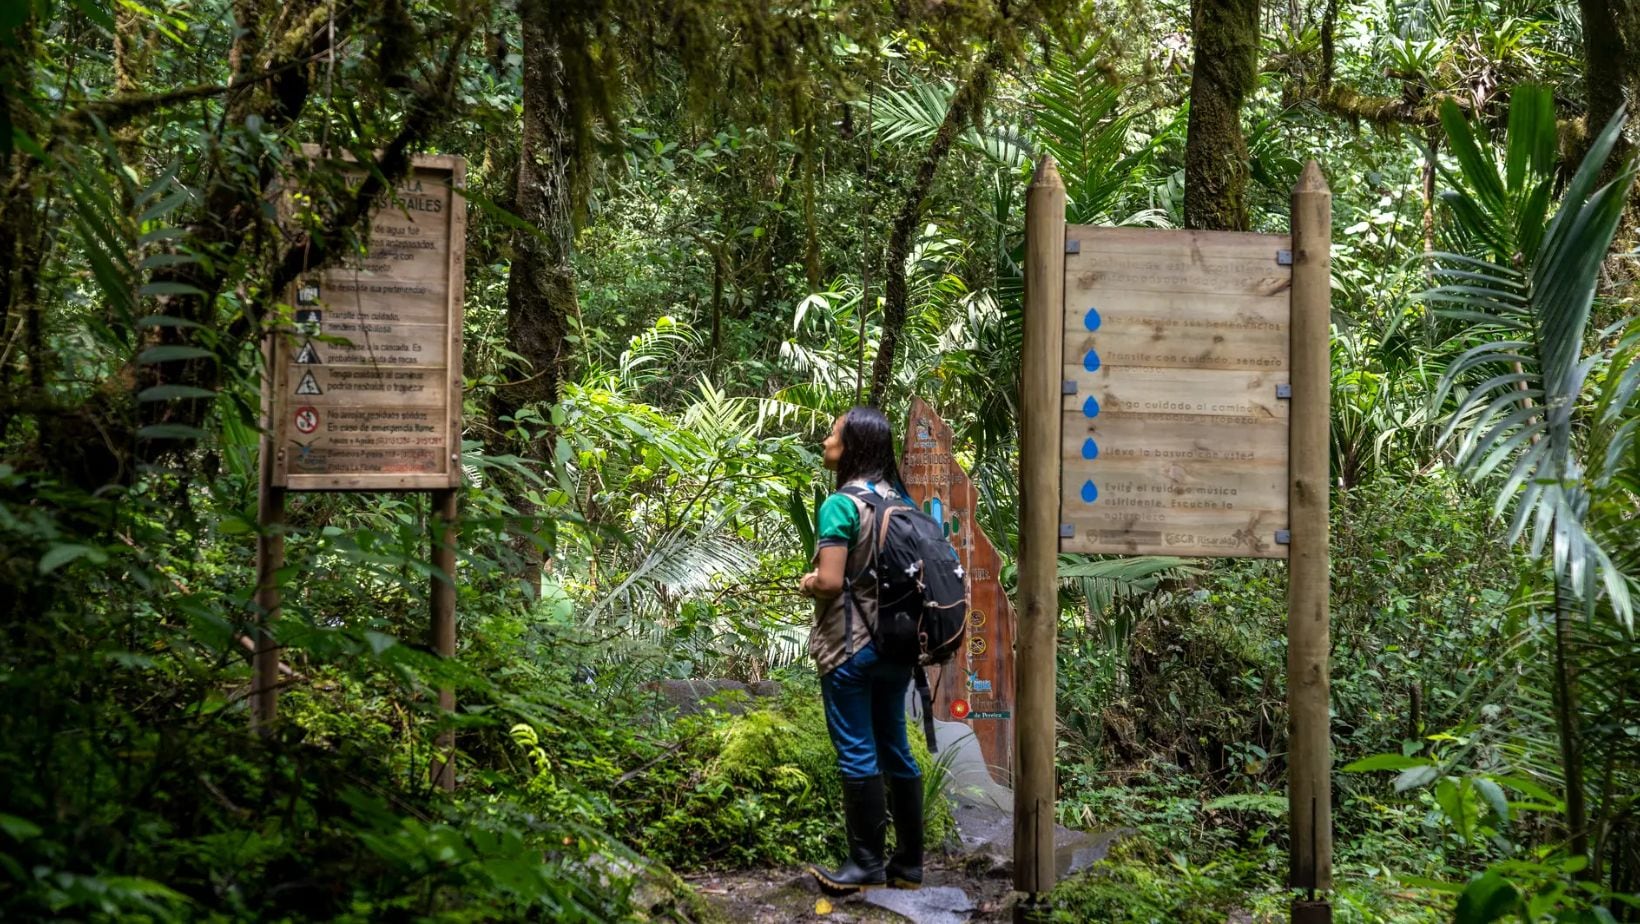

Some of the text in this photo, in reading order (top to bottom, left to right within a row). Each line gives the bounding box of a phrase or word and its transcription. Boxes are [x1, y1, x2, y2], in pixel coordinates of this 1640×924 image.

[1107, 351, 1152, 362] Transite
[1235, 356, 1281, 367] sendero
[1144, 400, 1192, 411] cuidado
[1195, 402, 1208, 412] al
[1139, 447, 1150, 457] la
[1154, 448, 1194, 459] basura
[1136, 483, 1148, 493] el
[1171, 499, 1217, 510] Escuche
[1221, 500, 1234, 510] la
